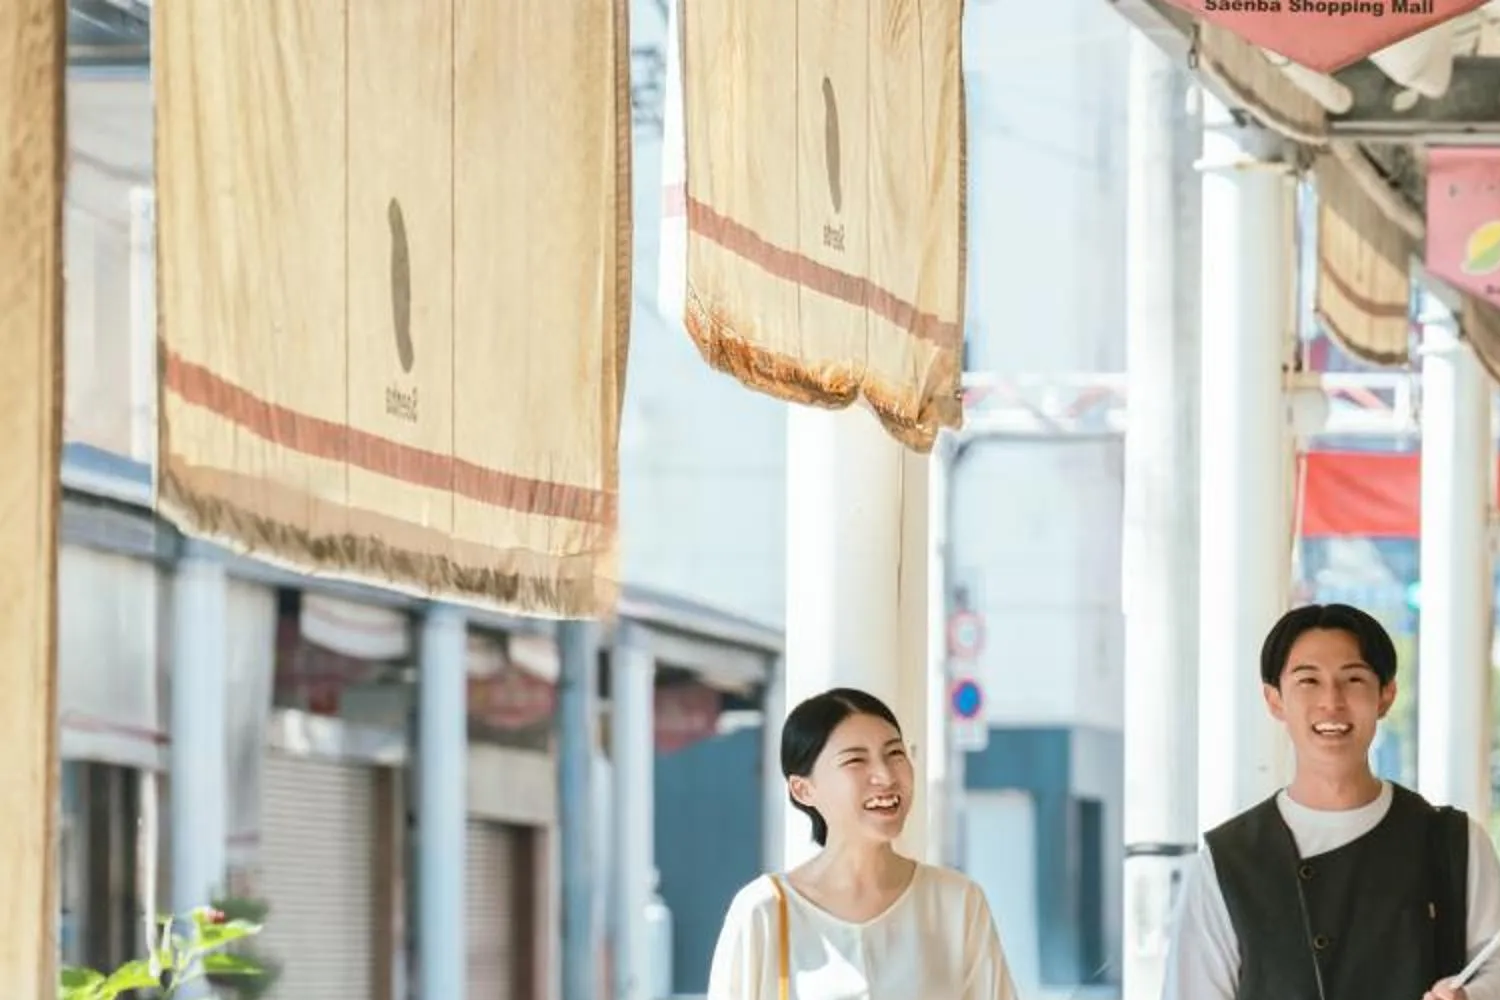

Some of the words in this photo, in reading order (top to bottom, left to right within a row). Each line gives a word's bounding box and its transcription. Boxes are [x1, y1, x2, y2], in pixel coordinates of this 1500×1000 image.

[1205, 0, 1281, 12] Saenba
[1289, 0, 1384, 17] Shopping
[1392, 0, 1434, 14] Mall
